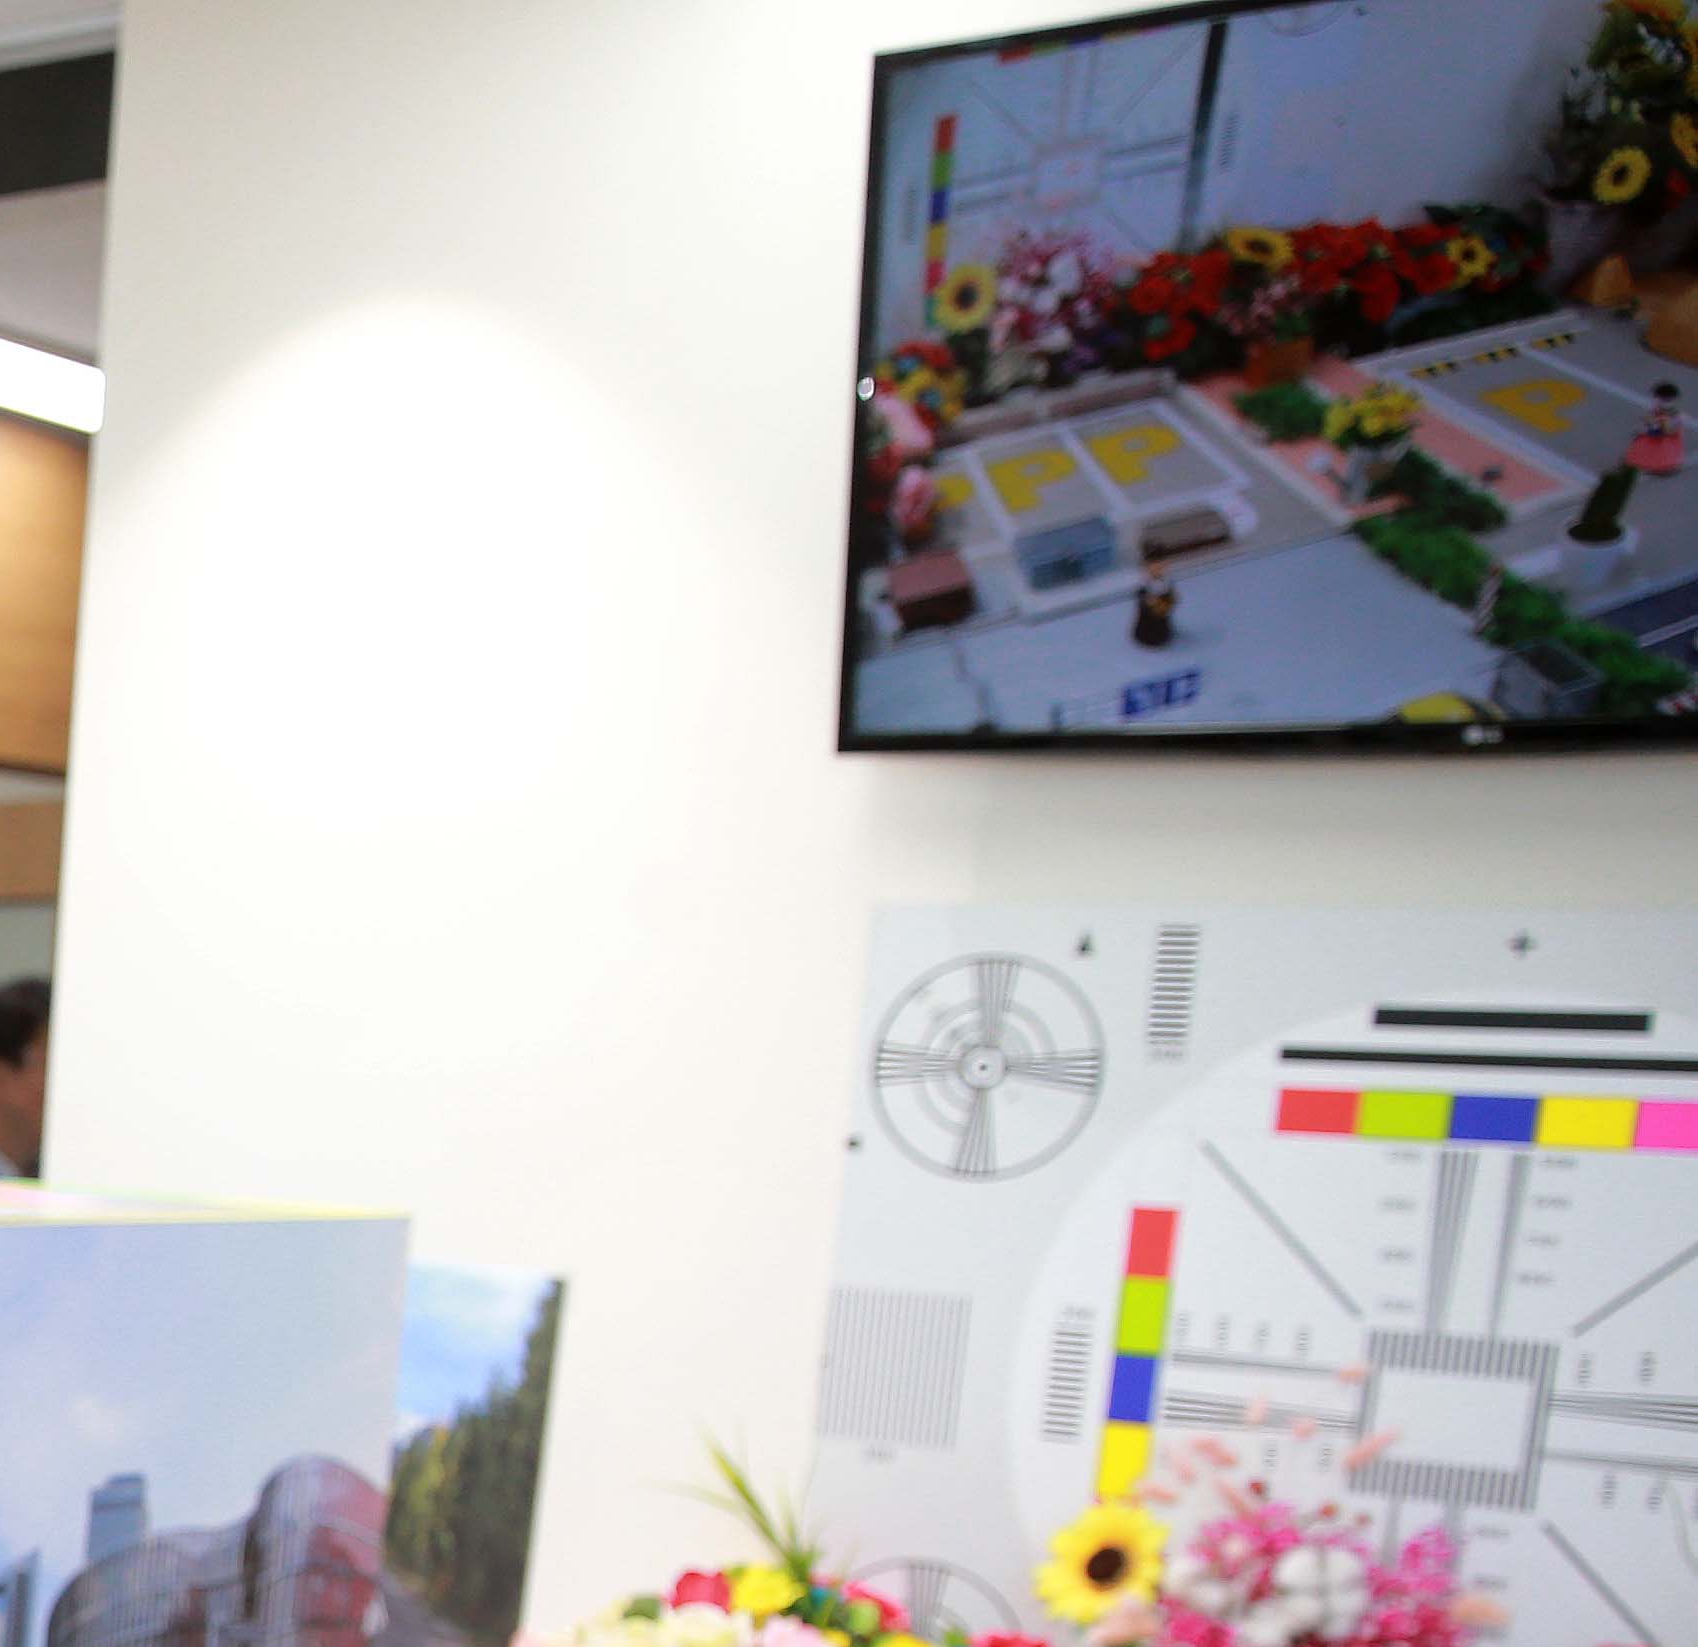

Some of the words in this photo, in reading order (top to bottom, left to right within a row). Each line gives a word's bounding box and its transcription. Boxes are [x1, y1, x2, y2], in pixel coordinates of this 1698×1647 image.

[1480, 379, 1587, 433] P
[985, 452, 1077, 514] P
[1088, 423, 1181, 487] P
